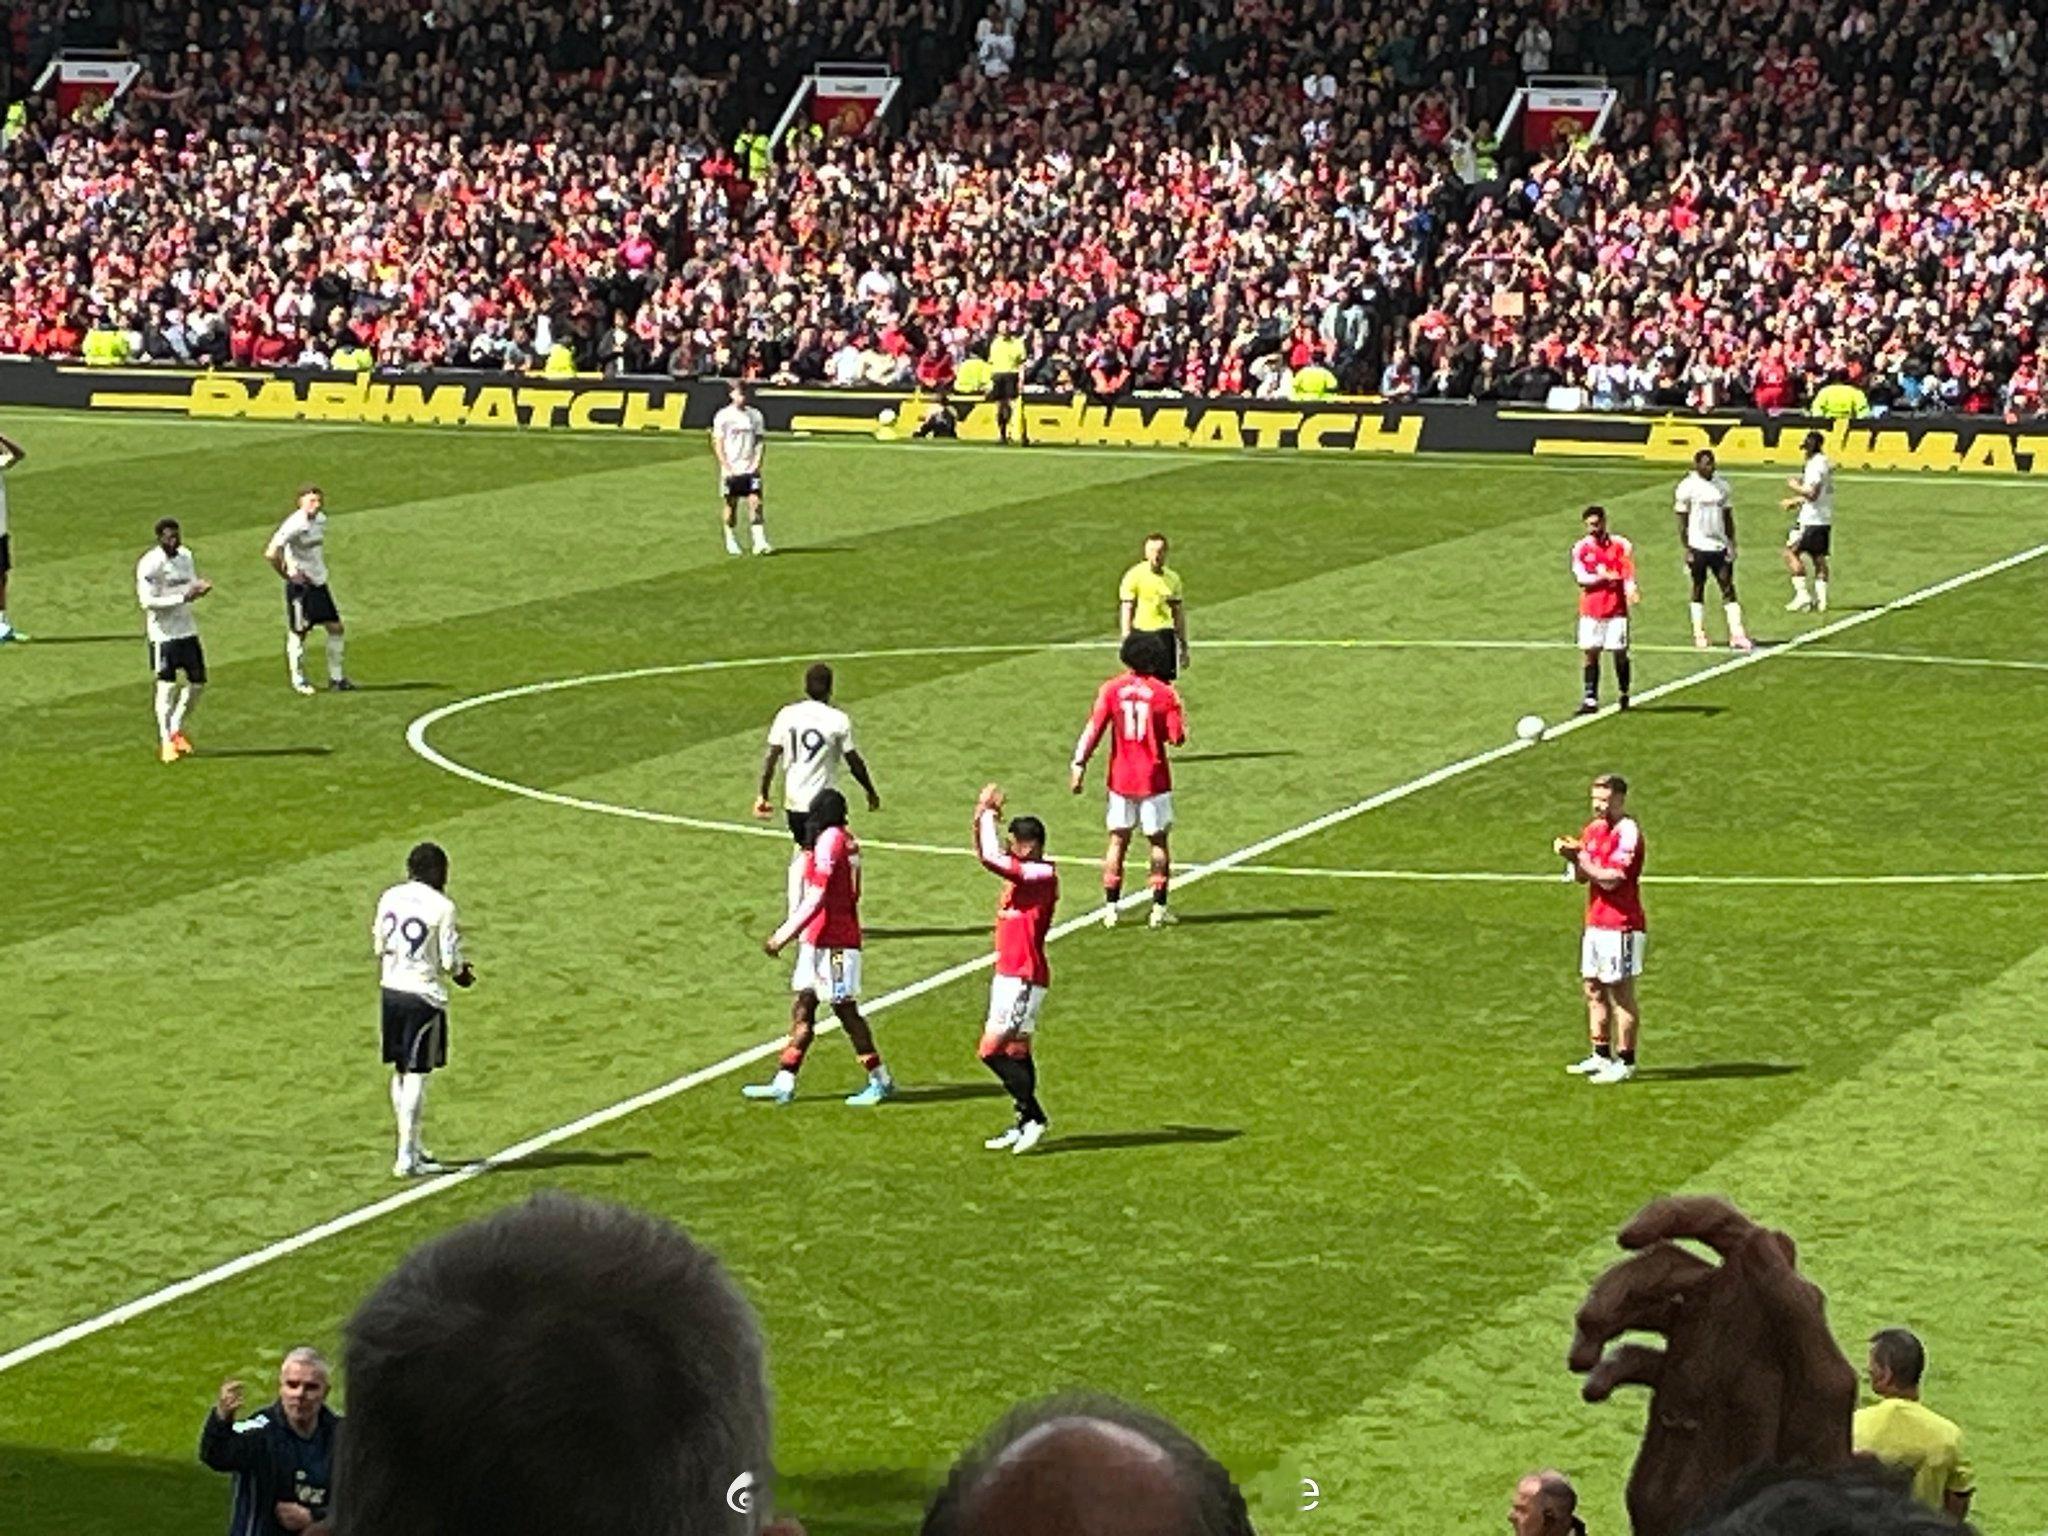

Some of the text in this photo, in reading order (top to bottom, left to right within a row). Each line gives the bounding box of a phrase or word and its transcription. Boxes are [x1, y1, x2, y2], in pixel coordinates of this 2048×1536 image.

[1119, 700, 1150, 743] 11
[788, 726, 826, 763] 19
[382, 910, 429, 957] 29
